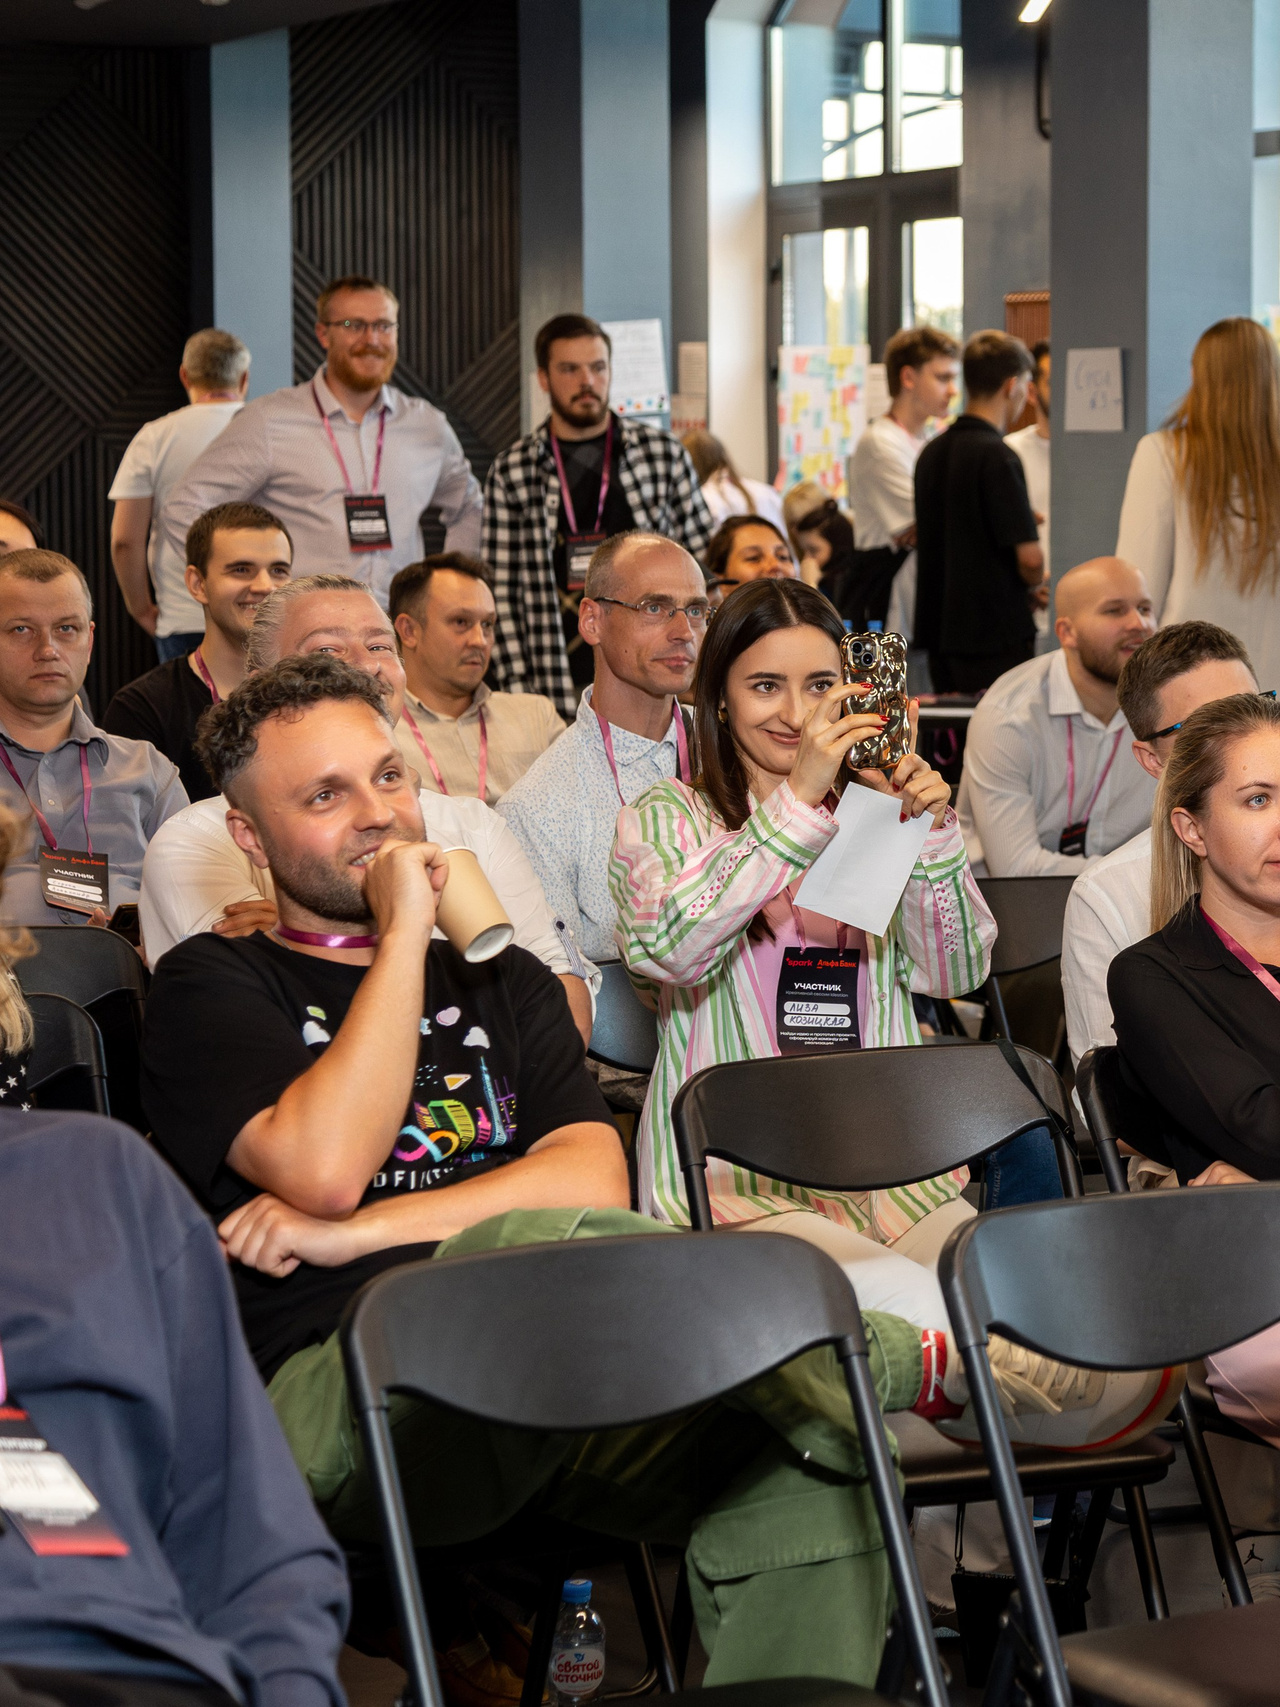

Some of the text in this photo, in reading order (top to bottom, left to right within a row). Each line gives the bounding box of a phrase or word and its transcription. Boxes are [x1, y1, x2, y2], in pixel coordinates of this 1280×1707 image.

[816, 959, 857, 968] Альфа Банк
[794, 982, 842, 992] УЧАСТНИК
[789, 1003, 819, 1013] ЛИЗА
